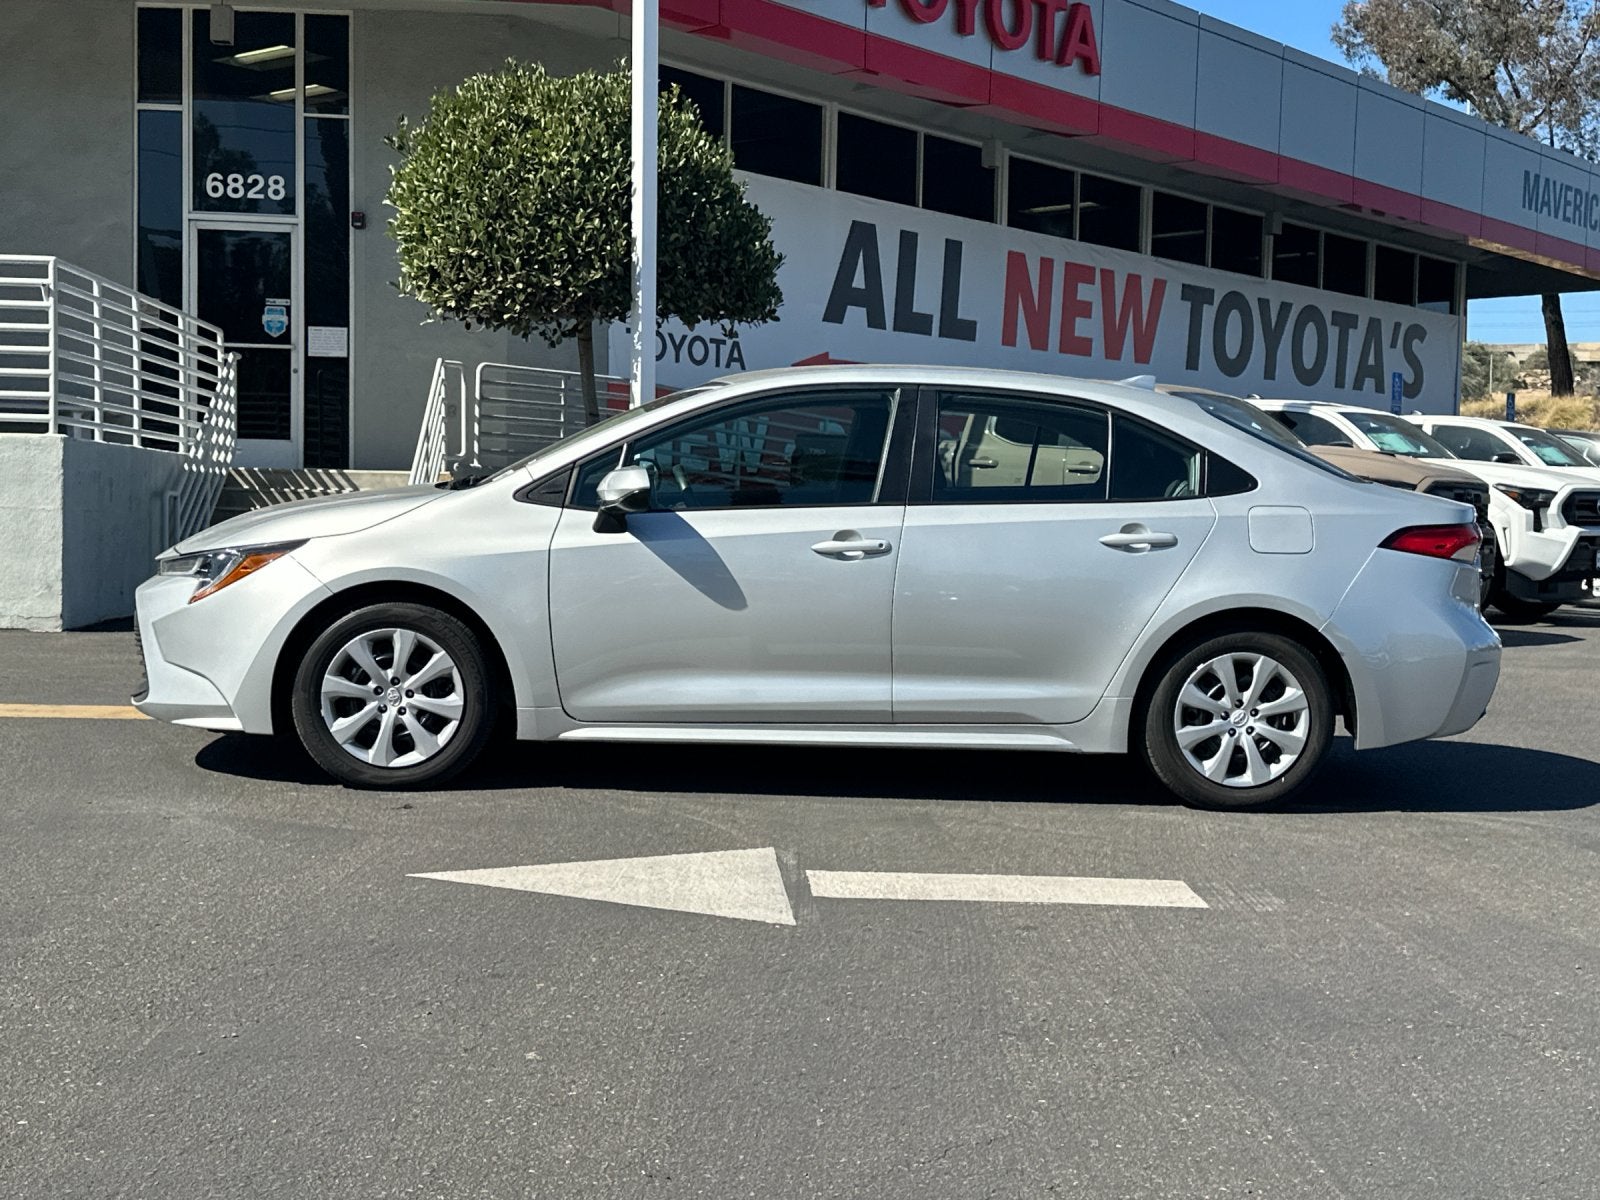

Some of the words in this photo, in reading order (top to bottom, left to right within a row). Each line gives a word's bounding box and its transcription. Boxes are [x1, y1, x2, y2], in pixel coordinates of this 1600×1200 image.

[205, 172, 286, 200] 6828
[1522, 169, 1600, 232] MAVERIC
[822, 220, 978, 342] ALL
[1002, 250, 1167, 365] NEW
[1181, 283, 1428, 400] TOYOTA'S
[625, 328, 746, 370] OYOTA
